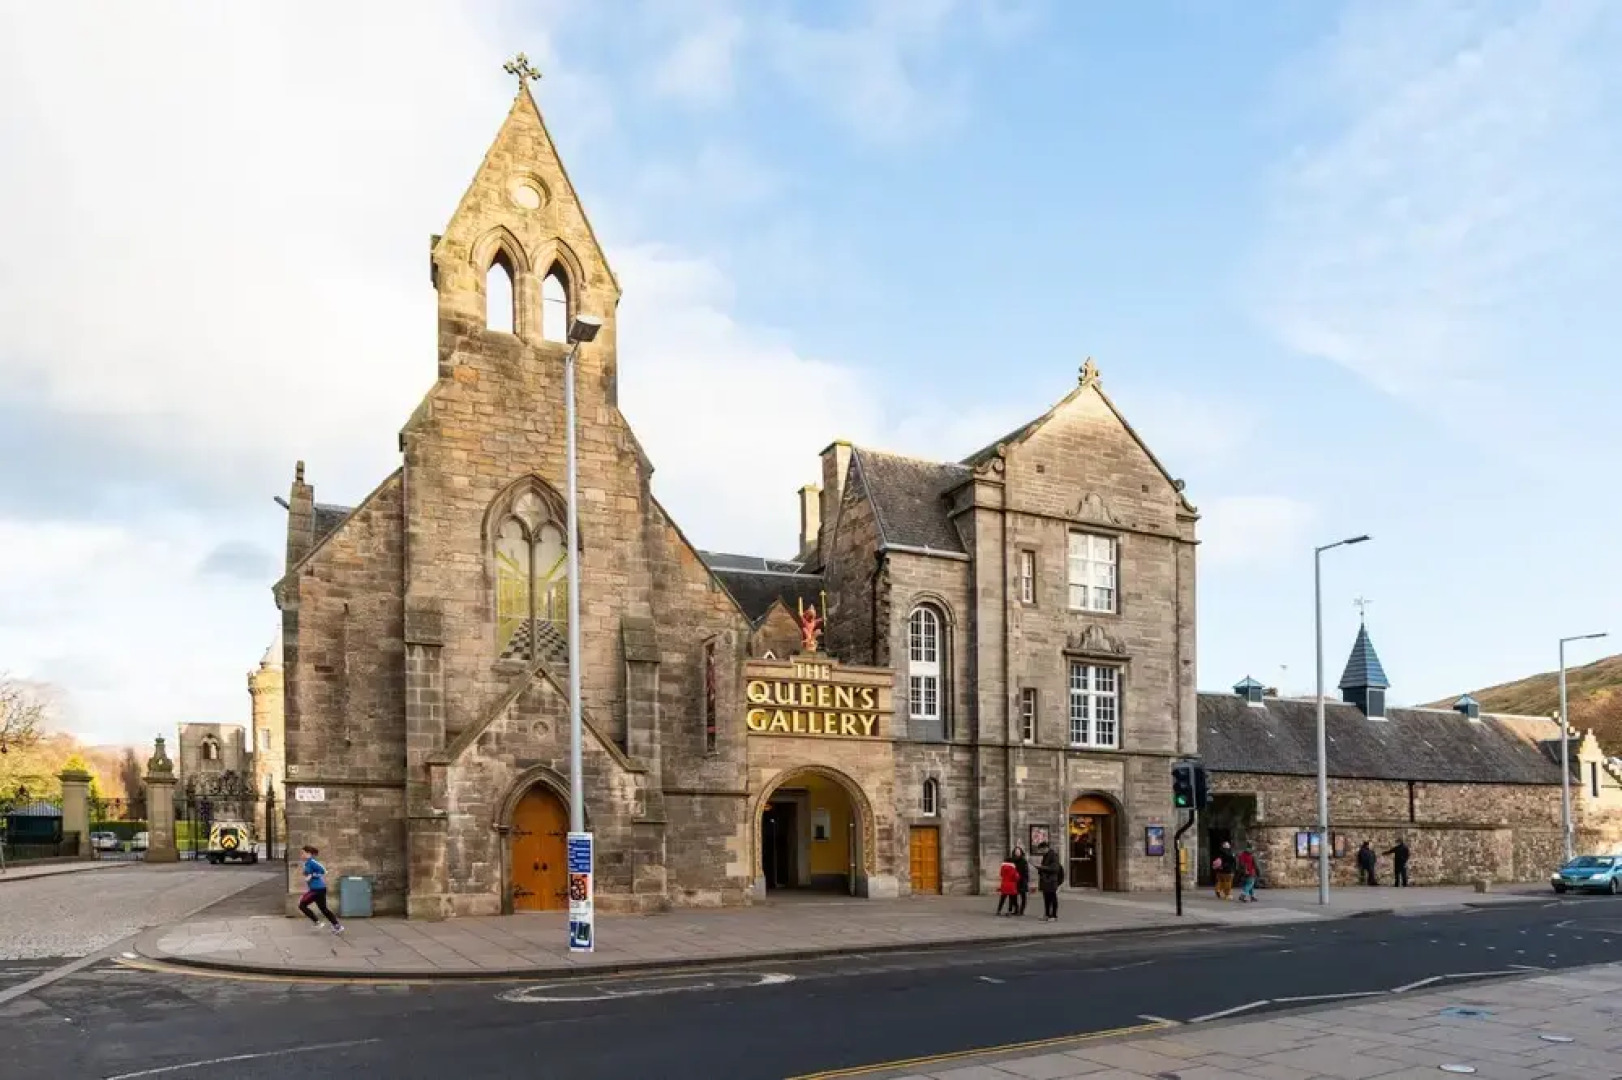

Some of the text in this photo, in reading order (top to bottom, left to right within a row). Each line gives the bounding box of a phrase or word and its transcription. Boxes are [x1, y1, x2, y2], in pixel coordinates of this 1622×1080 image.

[797, 663, 830, 680] THE
[747, 680, 875, 710] QUEEN'S
[746, 708, 877, 736] GALLERY
